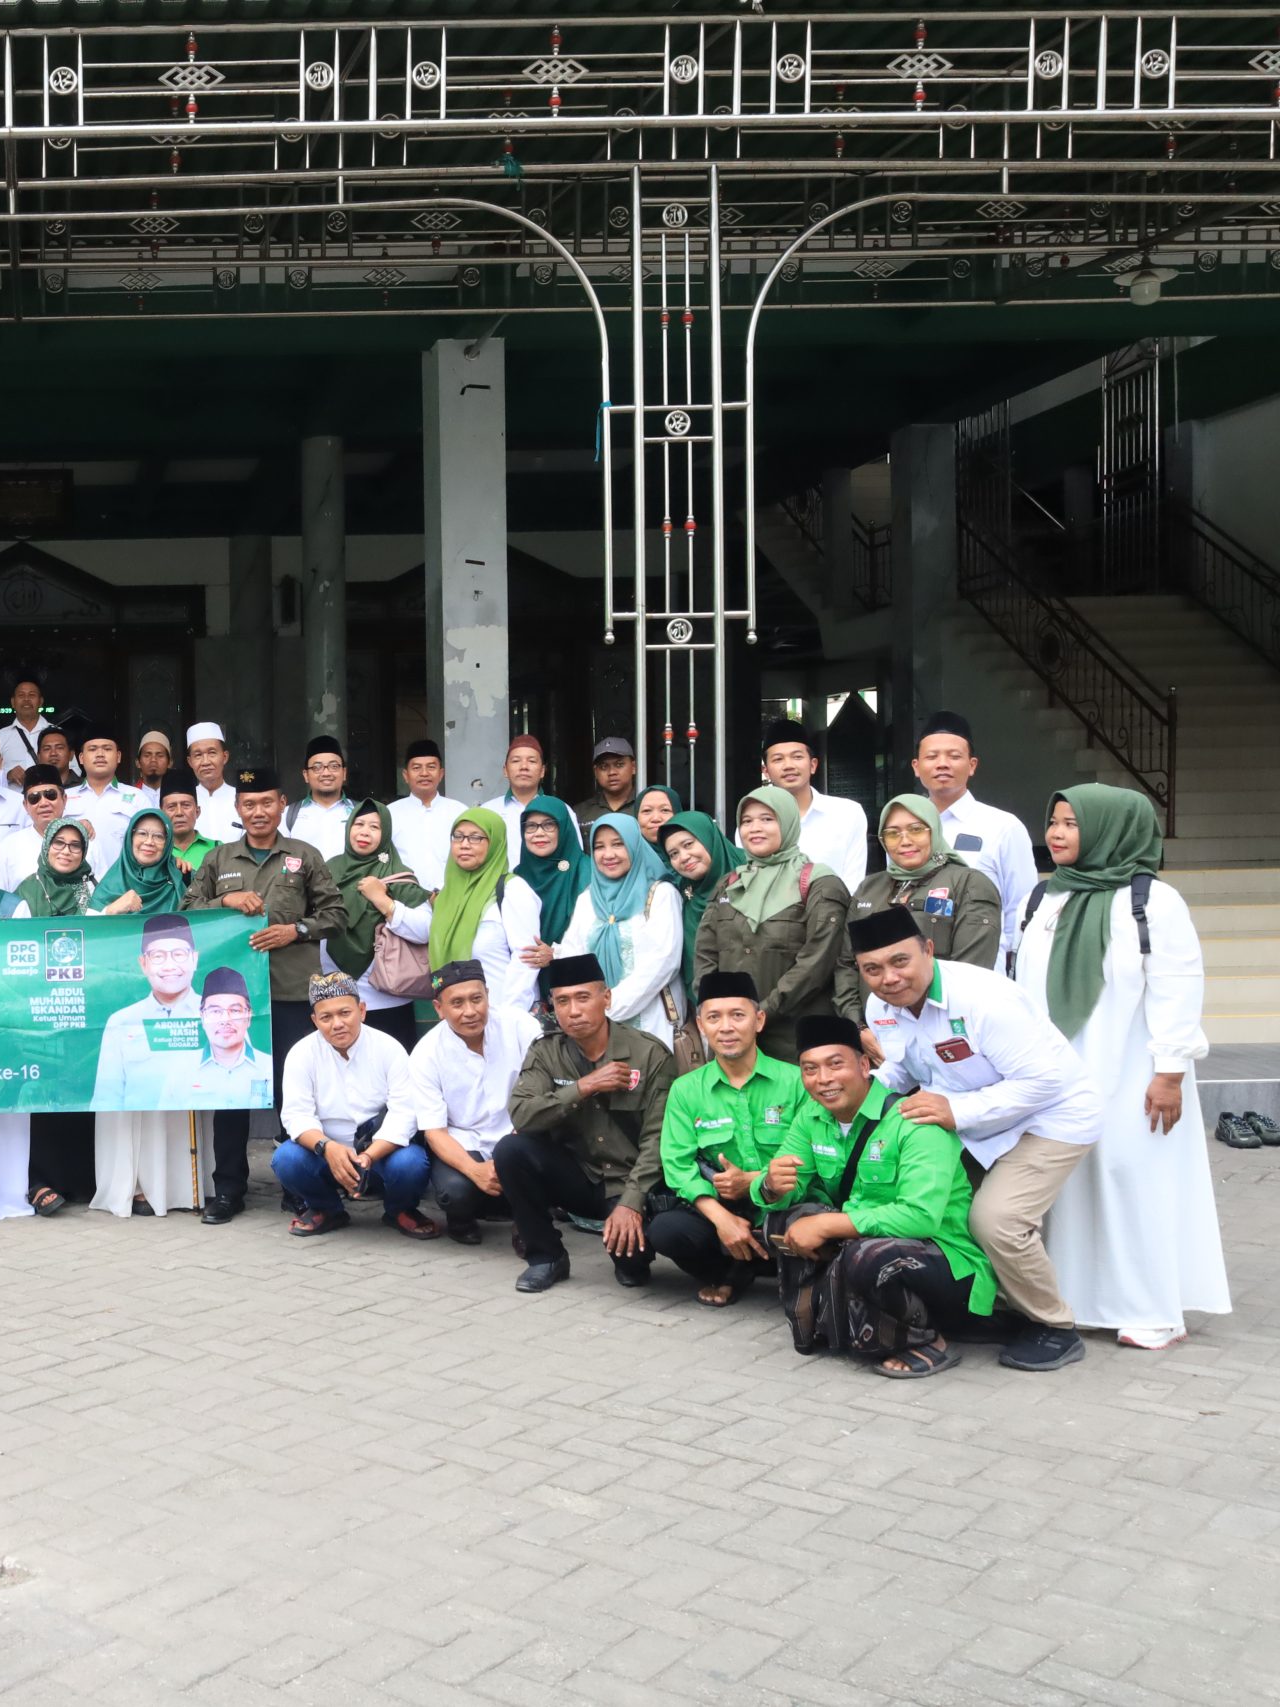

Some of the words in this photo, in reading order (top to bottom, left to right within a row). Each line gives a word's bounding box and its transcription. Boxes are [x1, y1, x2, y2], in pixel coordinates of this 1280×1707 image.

[10, 944, 36, 953] DPC
[10, 954, 36, 962] PKB
[46, 968, 83, 980] PKB
[50, 988, 84, 996] ABDUL
[30, 996, 85, 1005] MUHAIMIN
[31, 1006, 85, 1014] ISKANDAR
